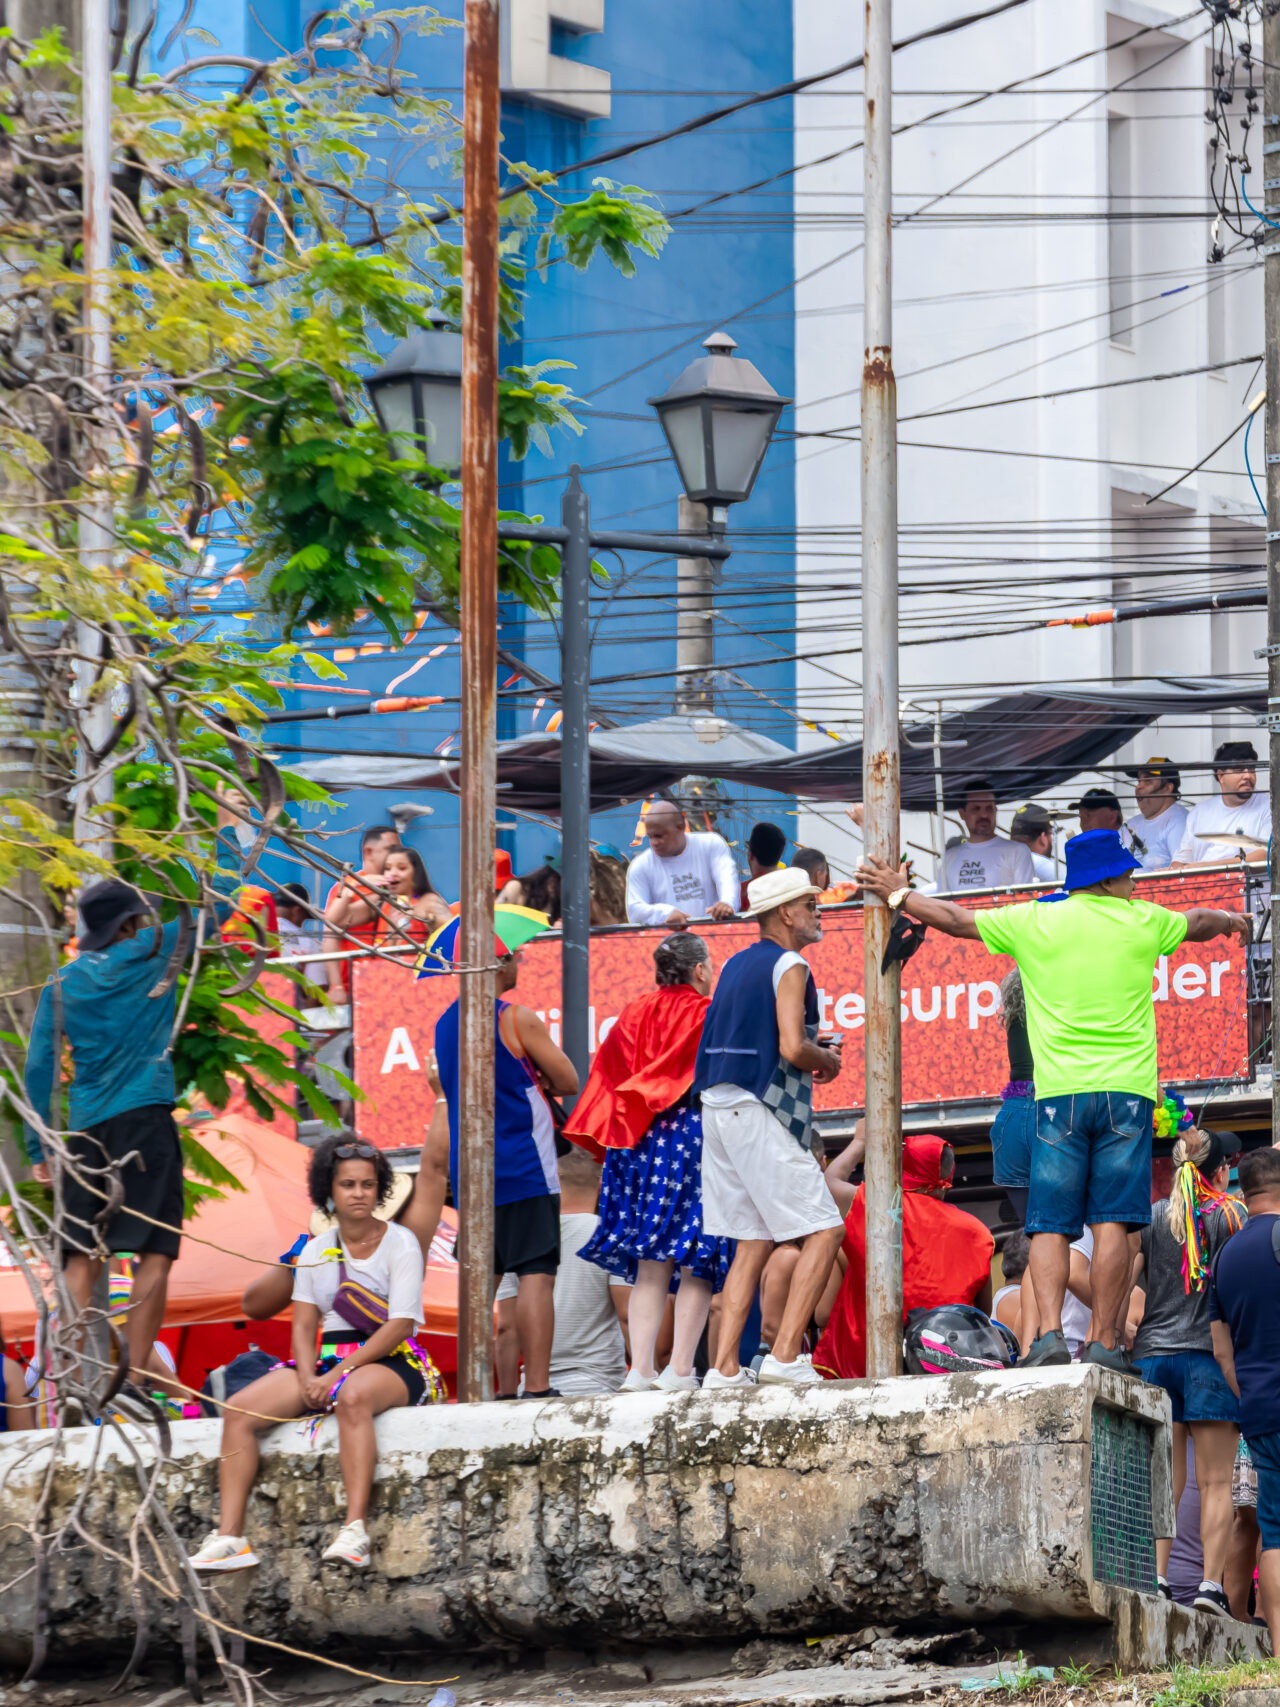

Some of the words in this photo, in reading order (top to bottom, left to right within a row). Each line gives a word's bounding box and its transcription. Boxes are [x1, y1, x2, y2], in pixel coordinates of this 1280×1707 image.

[961, 861, 981, 869] AN
[959, 876, 986, 886] RIO
[380, 1027, 420, 1074] A
